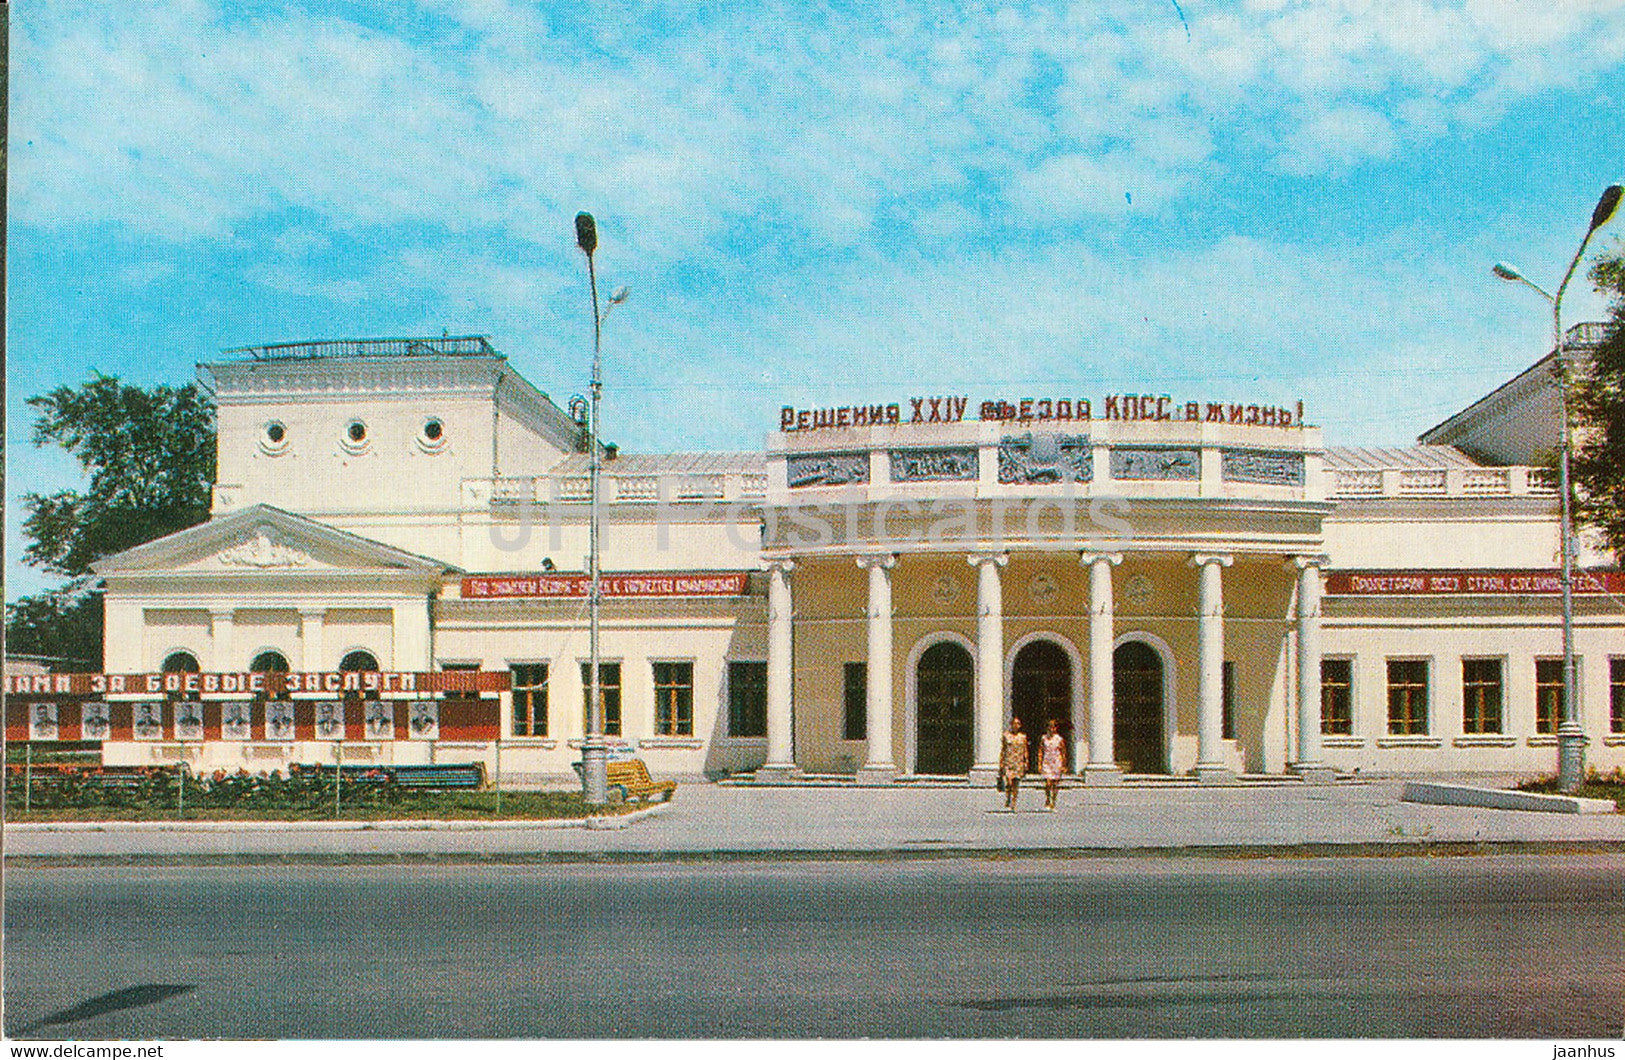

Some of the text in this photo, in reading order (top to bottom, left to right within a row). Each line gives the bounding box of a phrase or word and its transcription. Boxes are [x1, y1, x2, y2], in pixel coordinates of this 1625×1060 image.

[1106, 394, 1172, 421] КПСС
[91, 675, 125, 692] ЗА
[147, 675, 264, 692] БОЕВЫЕ
[286, 674, 415, 692] ЗАСЛУГИ
